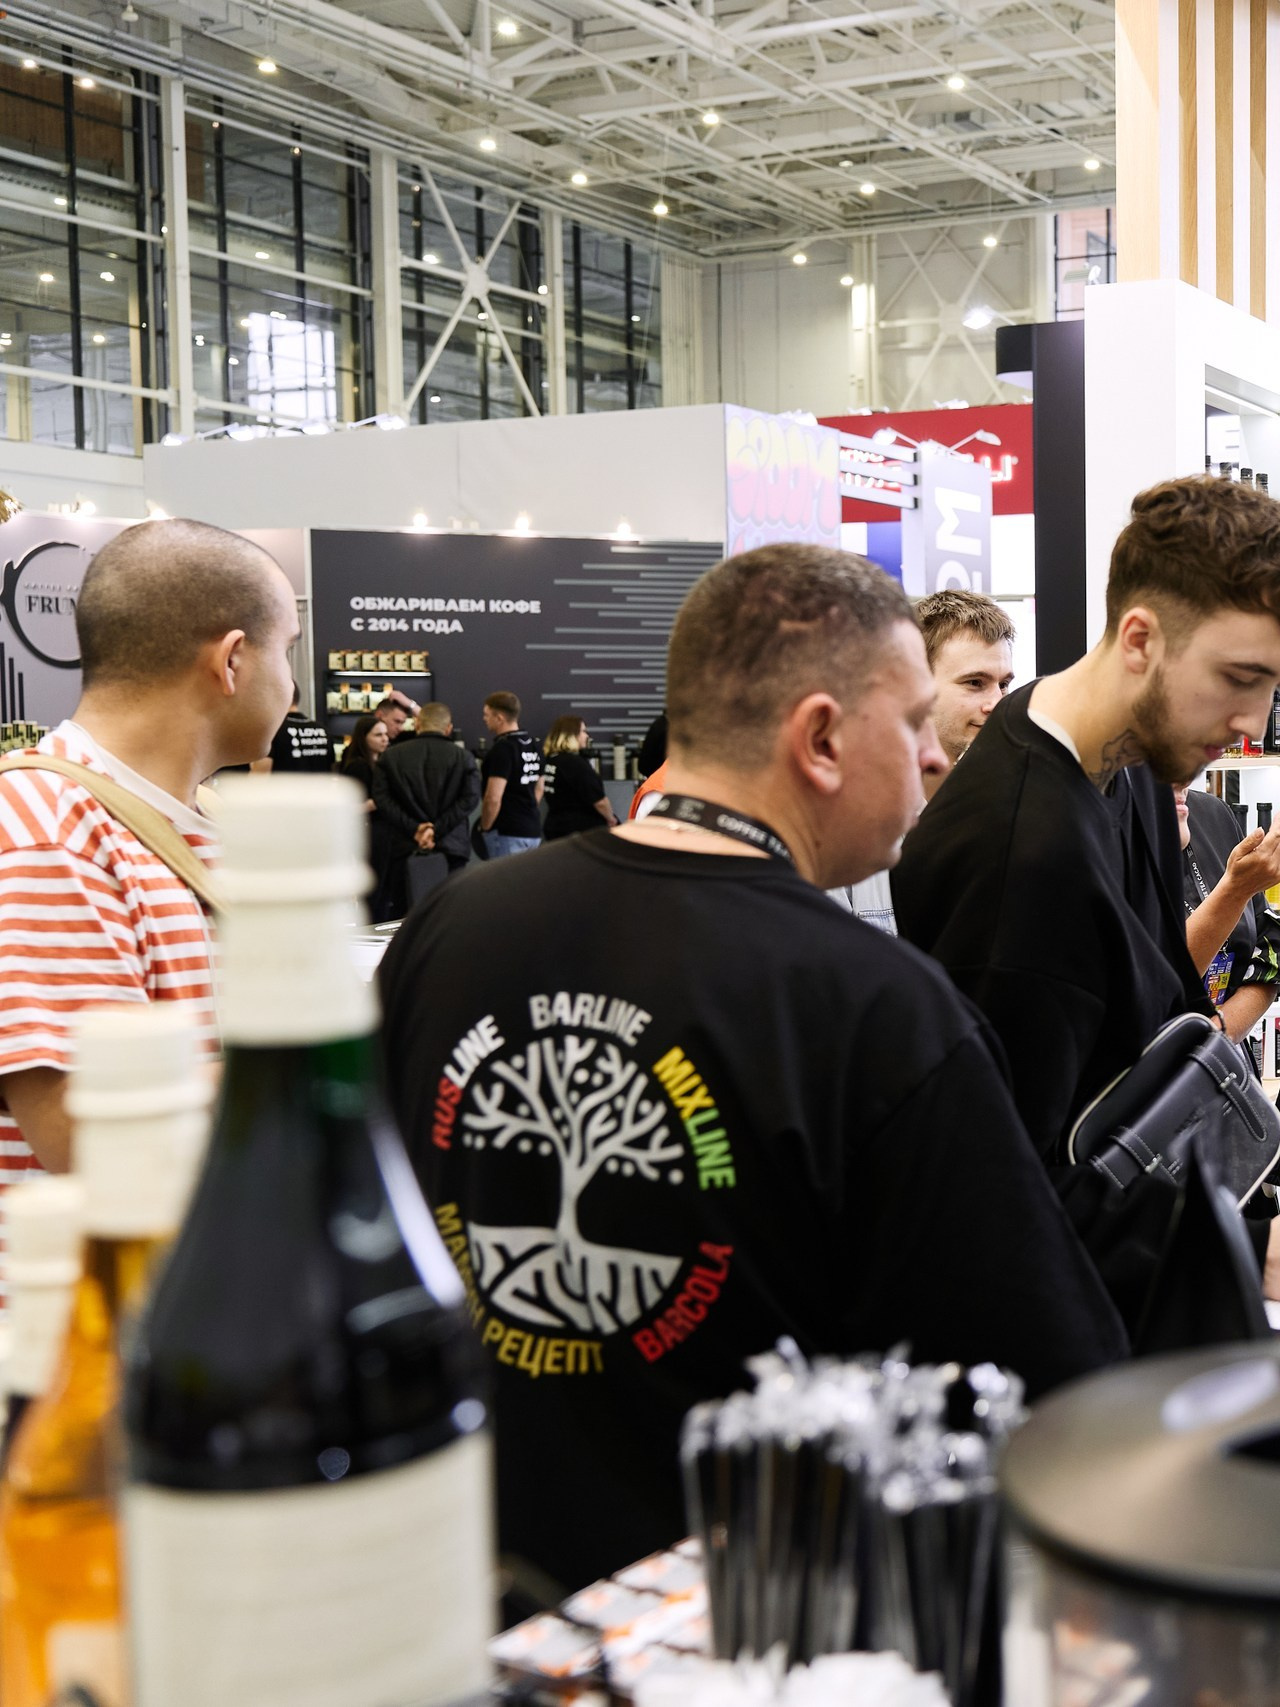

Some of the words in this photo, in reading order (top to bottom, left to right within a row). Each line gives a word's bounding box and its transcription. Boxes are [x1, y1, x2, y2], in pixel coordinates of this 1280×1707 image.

[350, 597, 485, 612] ОБЖАРИВАЕМ
[489, 600, 541, 614] КОФЕ
[351, 618, 364, 631] С
[368, 618, 409, 632] 2014
[413, 619, 464, 634] ГОДА
[529, 991, 653, 1047] BARLINE
[432, 1014, 506, 1150] RUSLINE
[652, 1046, 736, 1190] MIXLINE
[632, 1241, 734, 1364] BARCOLA
[482, 1317, 604, 1378] РЕЦЕПТ
